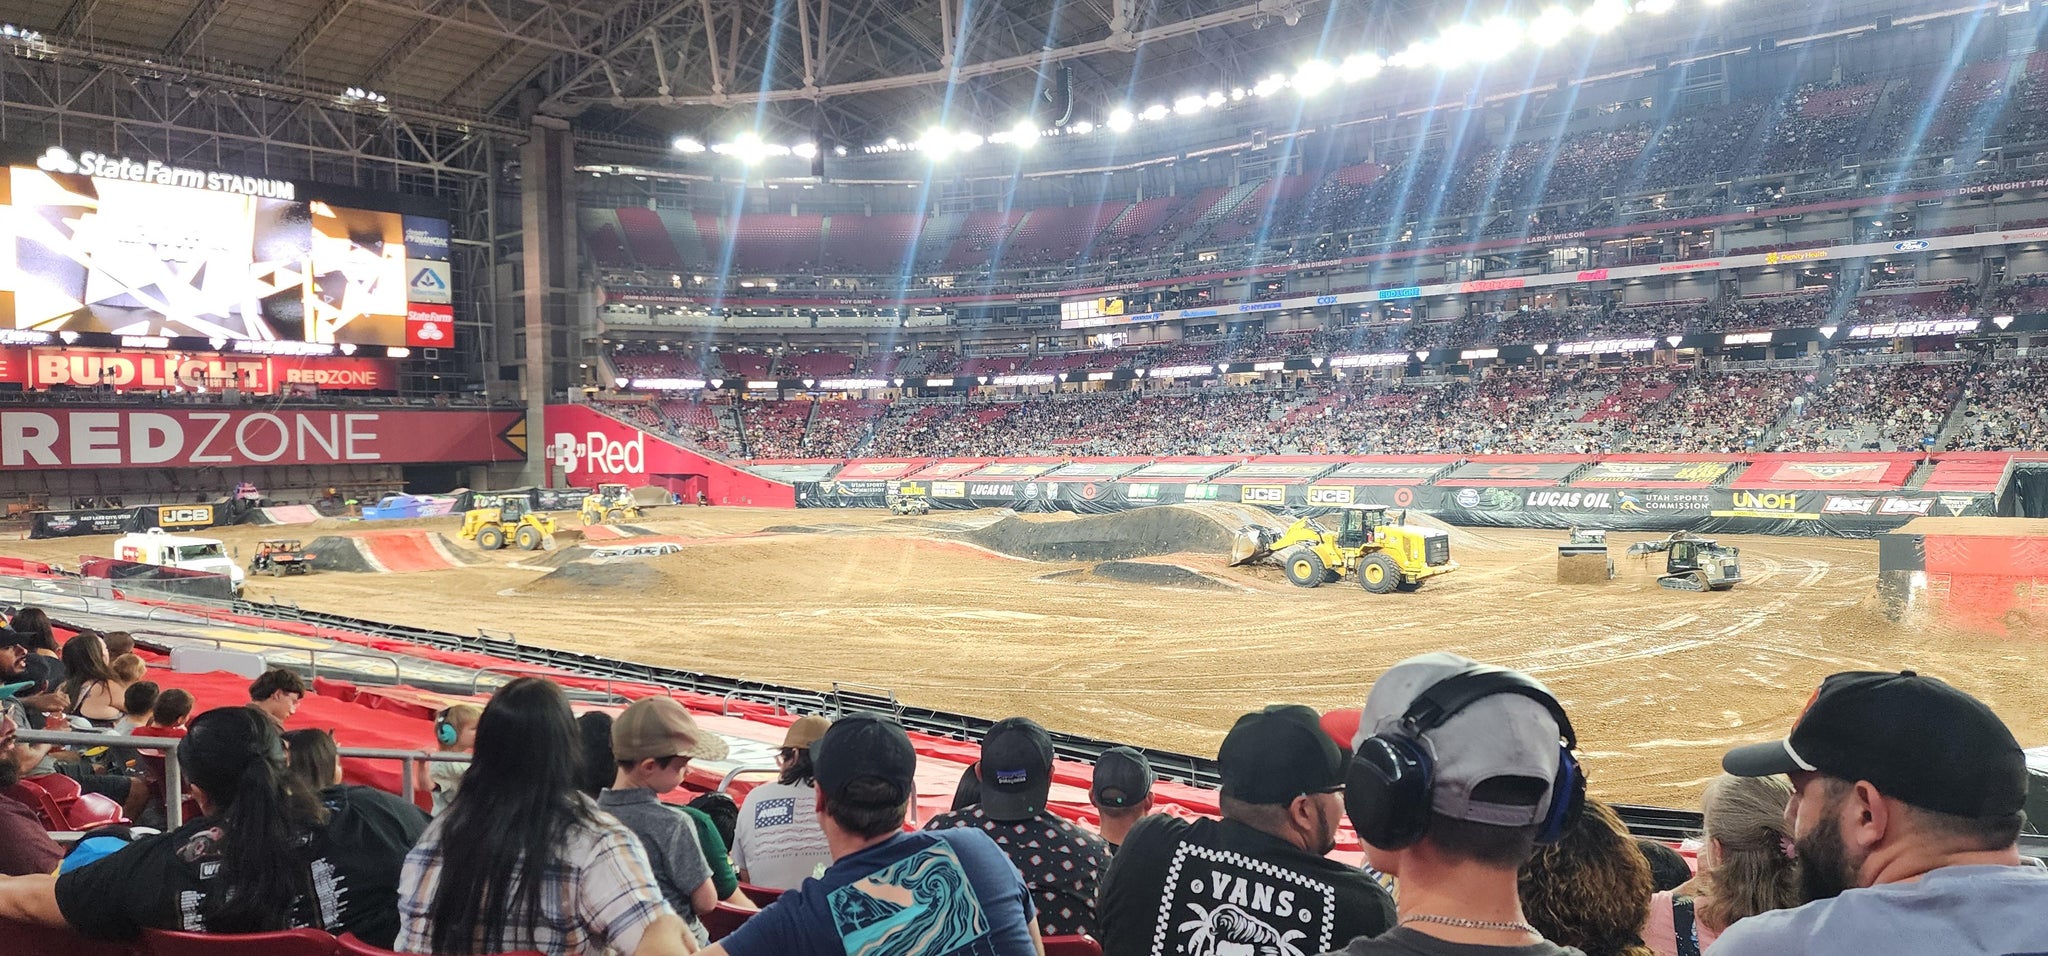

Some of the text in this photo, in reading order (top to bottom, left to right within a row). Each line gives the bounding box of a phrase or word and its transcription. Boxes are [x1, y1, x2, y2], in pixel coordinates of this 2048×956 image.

[207, 172, 295, 200] STADIUM
[1959, 185, 1985, 195] DICK
[1987, 181, 2027, 192] (NIGHT
[1526, 230, 1586, 243] LARRY WILSON
[1780, 250, 1828, 261] Dignity Health
[1317, 295, 1338, 304] COX
[38, 355, 136, 386] BUD
[141, 357, 263, 389] LIGHT
[971, 484, 998, 496] LUCAS
[1245, 488, 1282, 501] JCB
[1311, 489, 1350, 502] JCB
[1527, 490, 1582, 507] LUCAS
[1646, 494, 1710, 502] UTAH SPORTS
[1733, 490, 1796, 510] UNOH
[1645, 502, 1709, 511] COMMISSION
[163, 509, 209, 523] JCB
[1211, 870, 1295, 917] VANS
